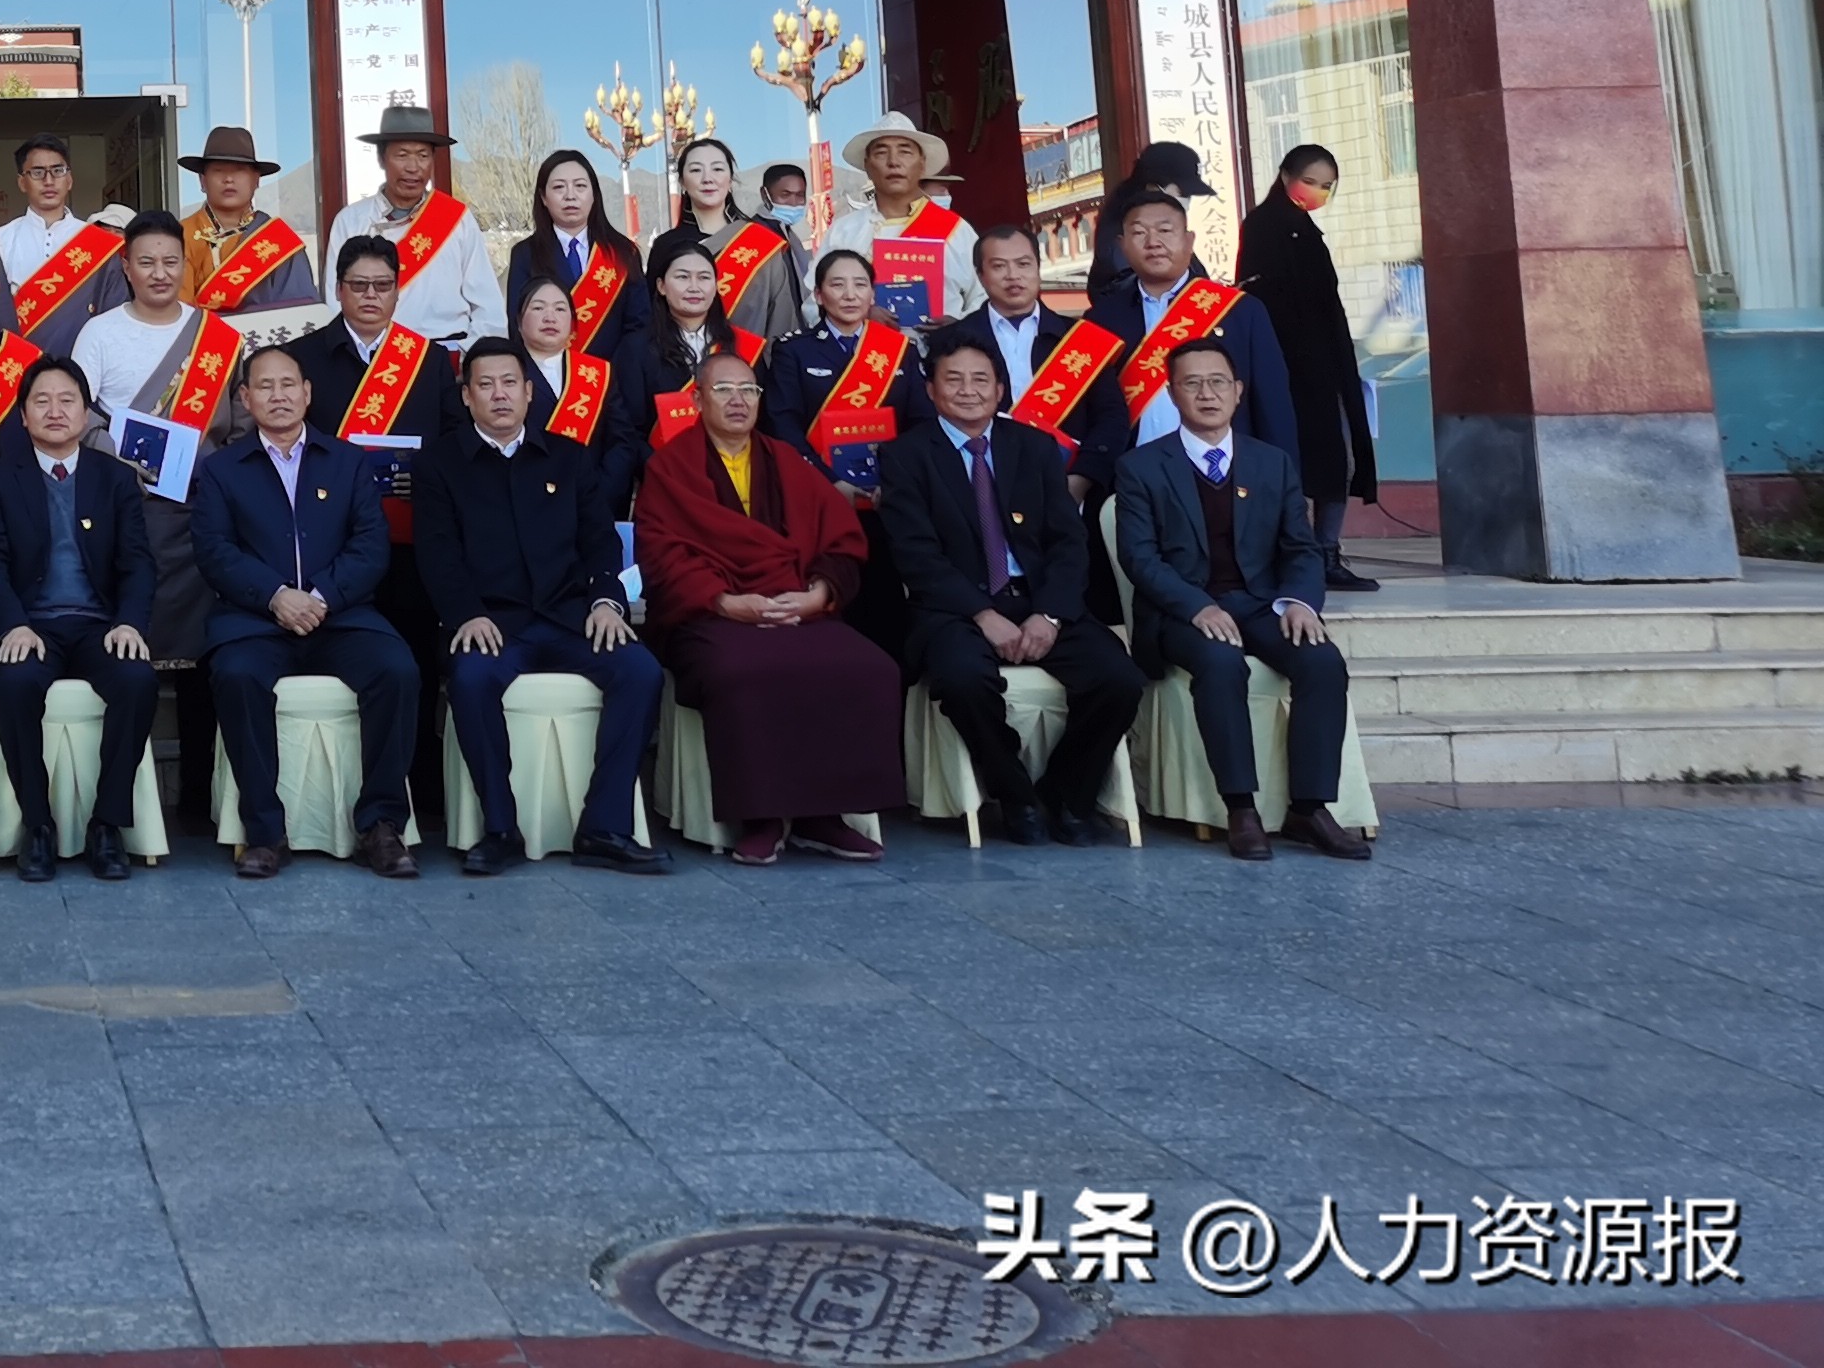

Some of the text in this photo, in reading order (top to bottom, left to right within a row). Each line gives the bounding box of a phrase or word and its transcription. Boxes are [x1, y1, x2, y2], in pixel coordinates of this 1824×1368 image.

[182, 351, 224, 414] 璞石
[356, 332, 417, 435] 璞石英
[841, 349, 890, 409] 璞石
[1124, 288, 1222, 406] 璞石英才
